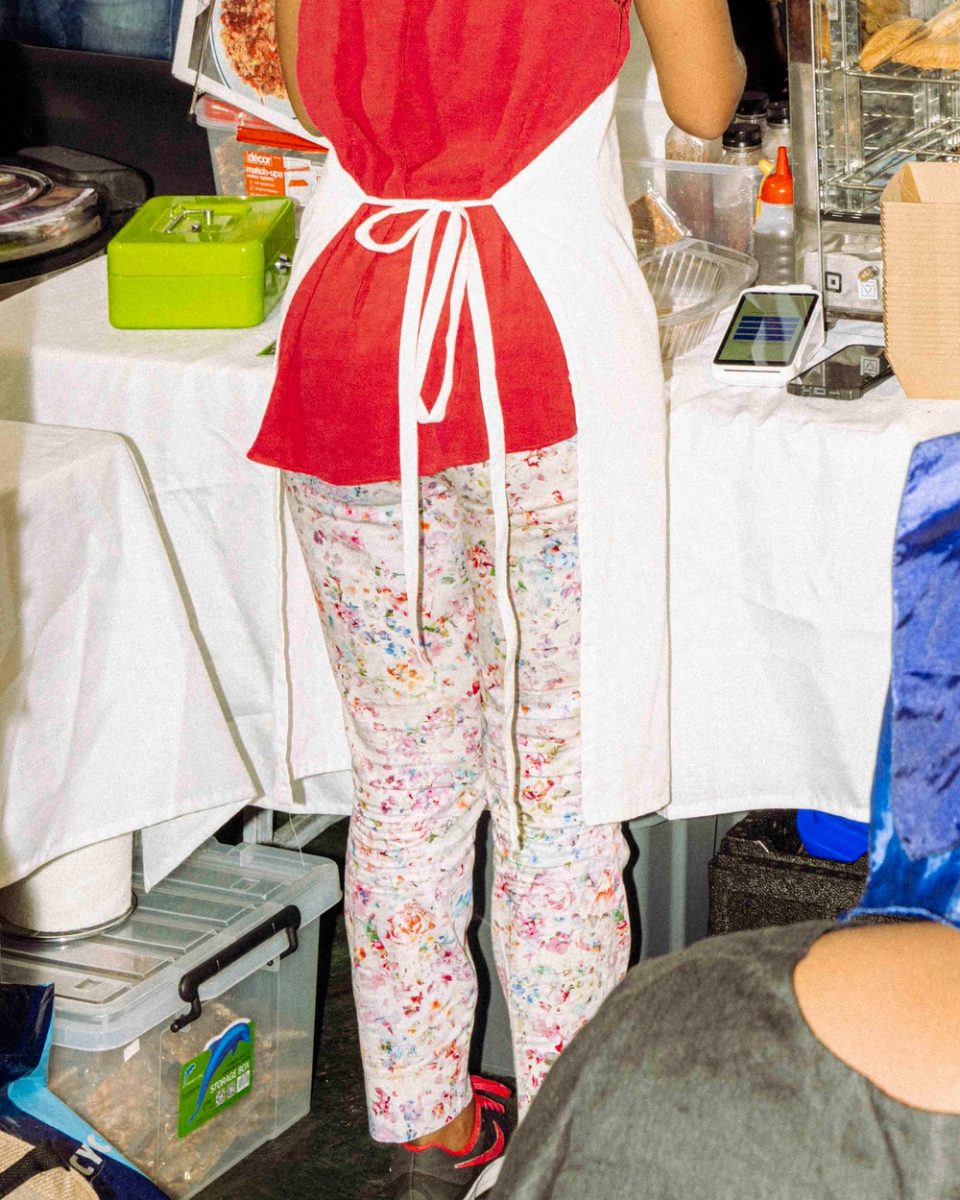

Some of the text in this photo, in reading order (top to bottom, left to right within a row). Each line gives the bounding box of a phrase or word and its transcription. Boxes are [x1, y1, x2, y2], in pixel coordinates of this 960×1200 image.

[246, 166, 283, 178] match-ups
[210, 1068, 237, 1094] STORAGE
[237, 1061, 250, 1076] BOX
